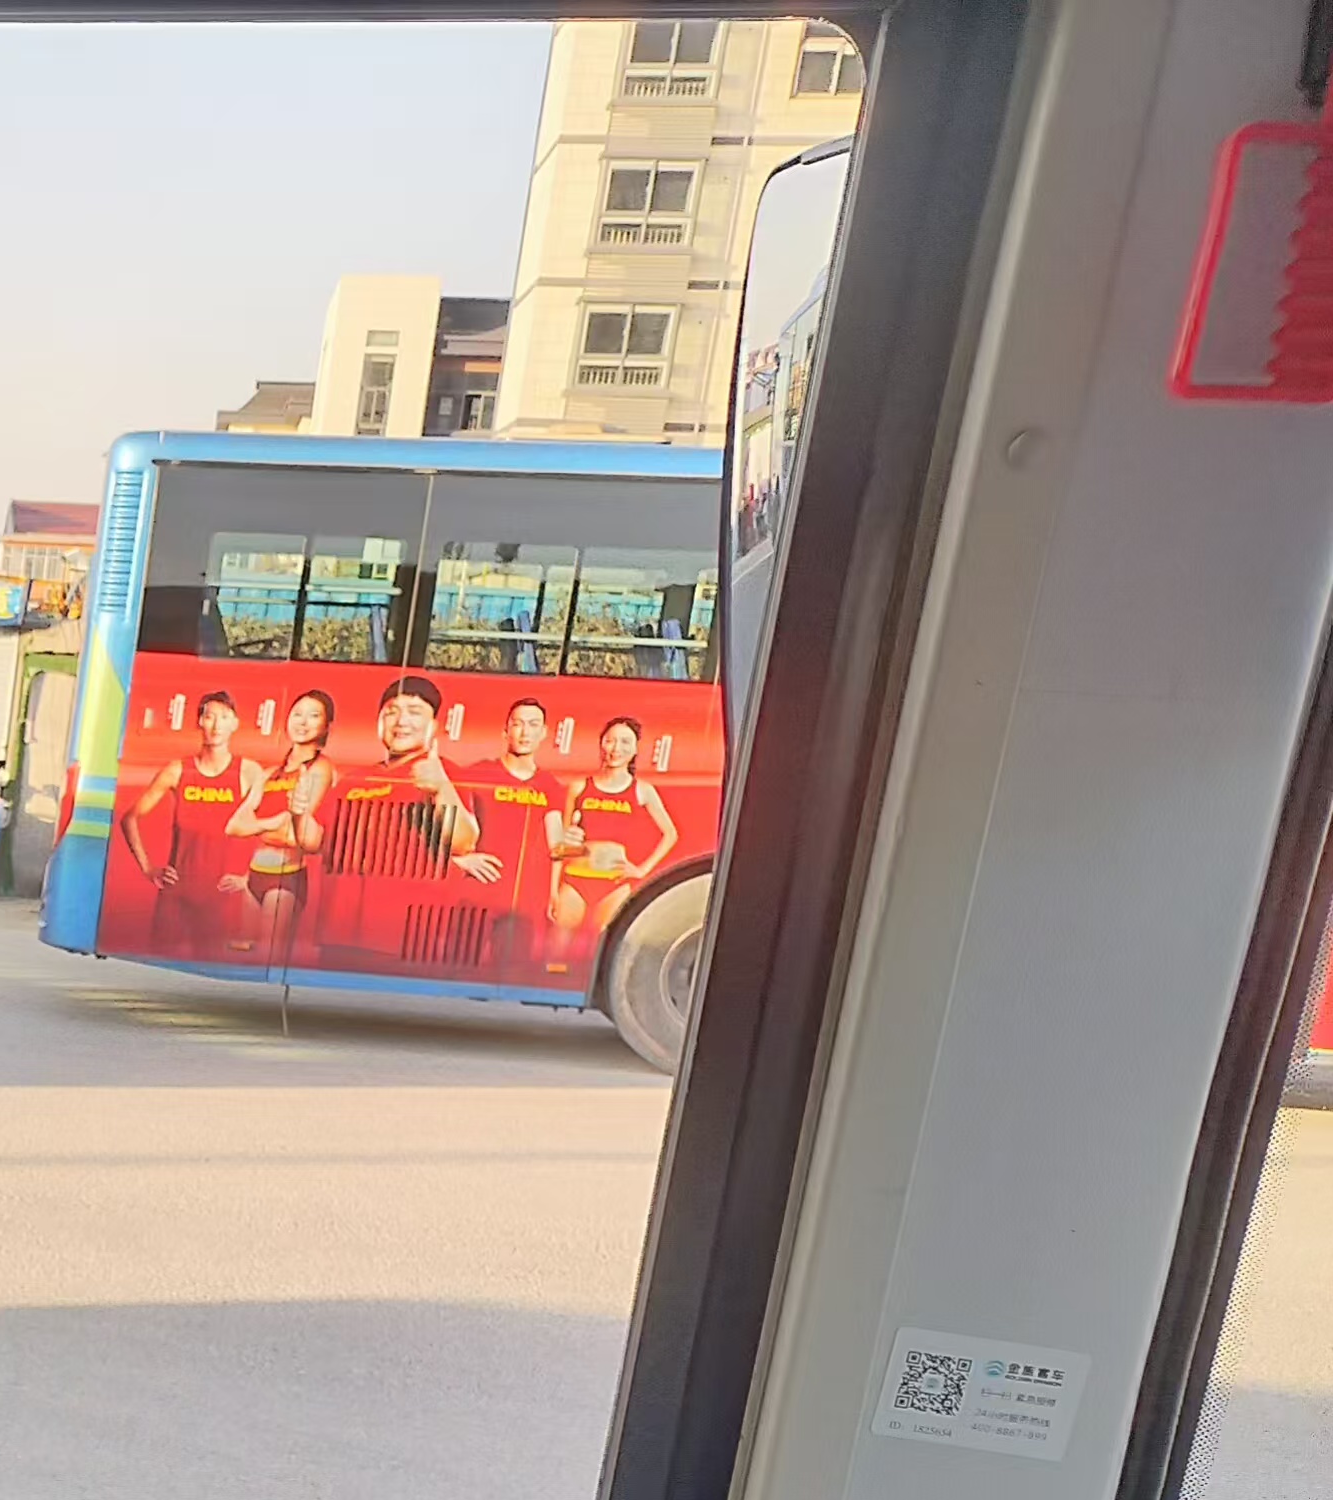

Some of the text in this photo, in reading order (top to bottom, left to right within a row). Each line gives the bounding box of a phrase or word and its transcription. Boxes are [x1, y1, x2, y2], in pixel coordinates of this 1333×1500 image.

[184, 786, 233, 803] CHINA
[494, 786, 548, 807] CHINA
[582, 797, 632, 814] CHINA
